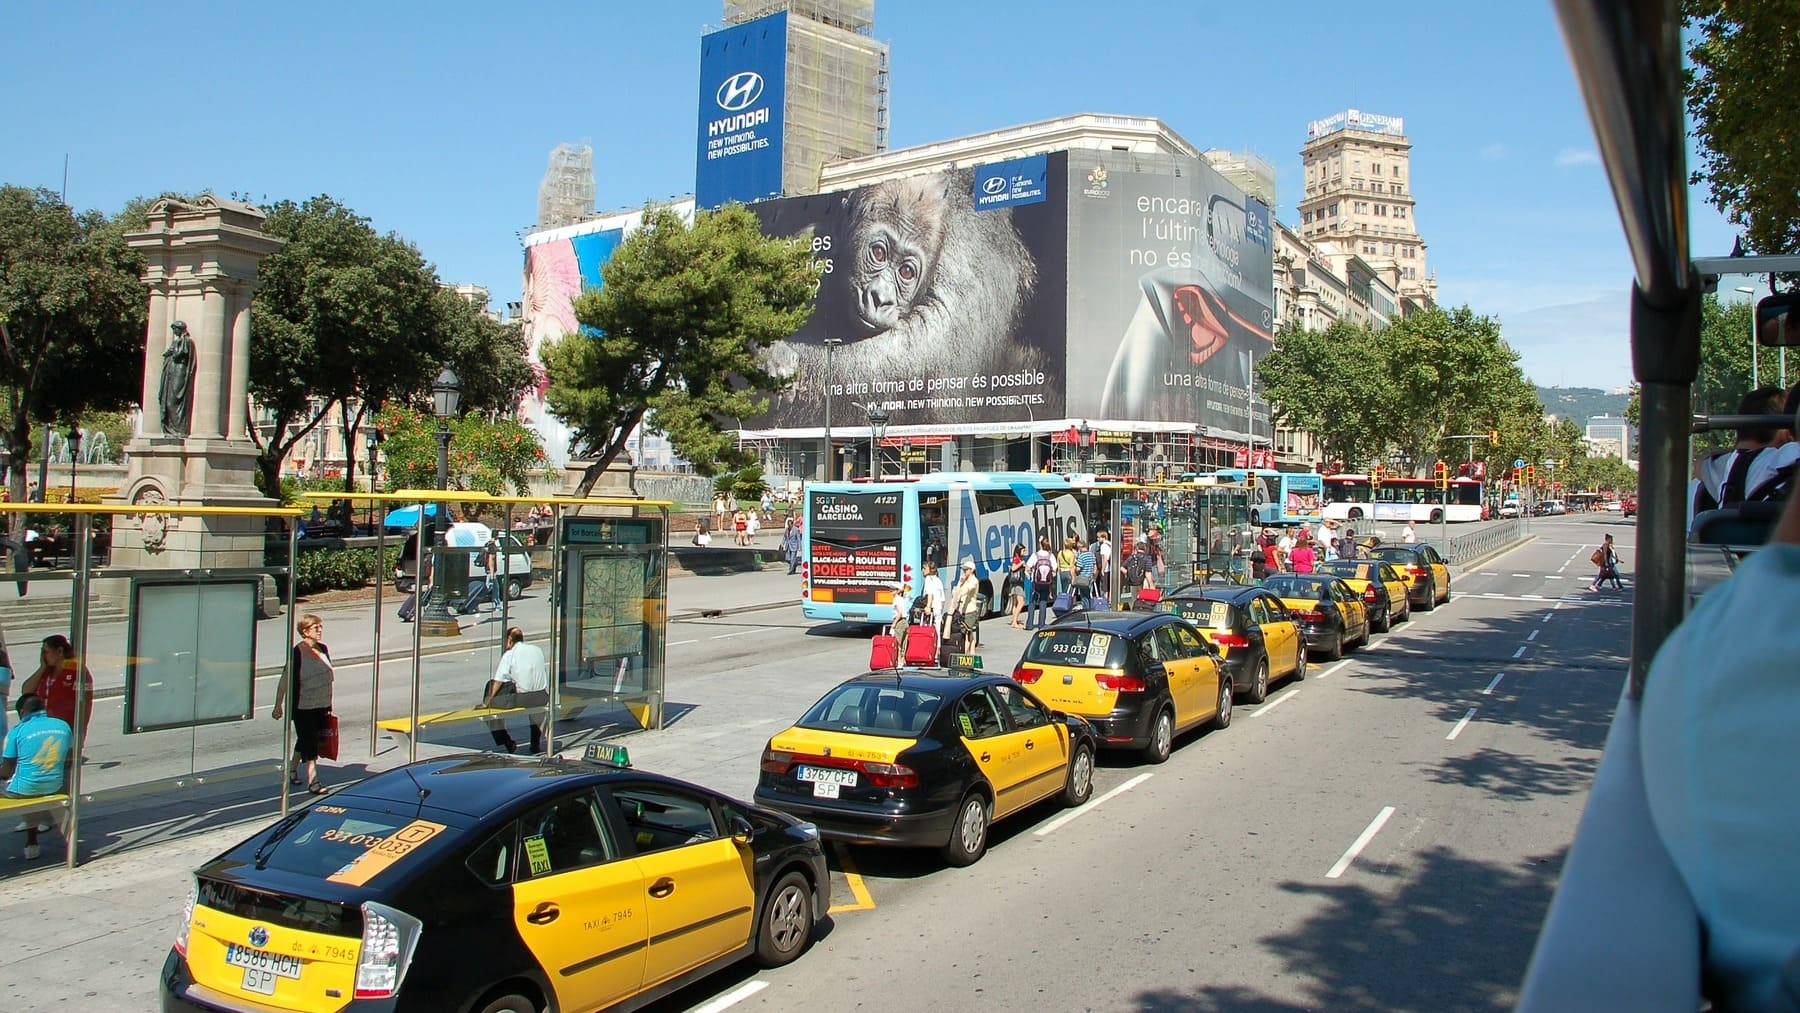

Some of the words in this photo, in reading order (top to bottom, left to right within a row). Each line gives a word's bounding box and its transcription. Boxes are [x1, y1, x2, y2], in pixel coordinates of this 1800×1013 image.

[709, 107, 769, 136] HYUNDAI
[708, 138, 723, 150] NEW
[725, 131, 756, 145] THINKING.
[708, 149, 723, 160] NEW
[724, 138, 769, 157] POSSIBILITIES.
[979, 193, 1009, 204] HYUNDAI
[1137, 195, 1202, 217] encara
[1130, 249, 1157, 266] no
[1167, 246, 1192, 268] és
[846, 380, 868, 394] altra
[872, 378, 905, 393] forma
[909, 376, 924, 392] de
[927, 377, 968, 394] pensar
[972, 373, 987, 388] és
[991, 369, 1045, 391] possible
[1164, 373, 1191, 386] una
[907, 400, 925, 410] NEW
[926, 398, 964, 409] THINKING.
[965, 397, 984, 407] NEW
[986, 394, 1045, 406] POSSIBILITIES.
[874, 496, 897, 504] A123
[822, 504, 859, 513] CASINO
[817, 513, 863, 521] BARCELONA
[856, 557, 896, 565] ROULETTE
[813, 564, 855, 576] POKER
[1196, 612, 1210, 620] 033
[1053, 644, 1069, 653] 933
[1070, 646, 1087, 654] 033
[959, 656, 973, 666] TAXI
[31, 735, 62, 769] 4
[597, 745, 614, 761] TAXI
[805, 767, 831, 780] 3767
[834, 771, 854, 784] CFG
[817, 783, 836, 796] SP
[321, 829, 352, 842] 933
[350, 834, 380, 848] 033
[379, 840, 411, 855] 033
[408, 829, 424, 839] T
[532, 859, 550, 874] TAXI
[584, 919, 600, 931] TAXI
[613, 908, 632, 922] 7945
[235, 944, 268, 970] 8586
[270, 952, 300, 976] HCH
[325, 945, 354, 961] 7945
[247, 968, 273, 989] SP
